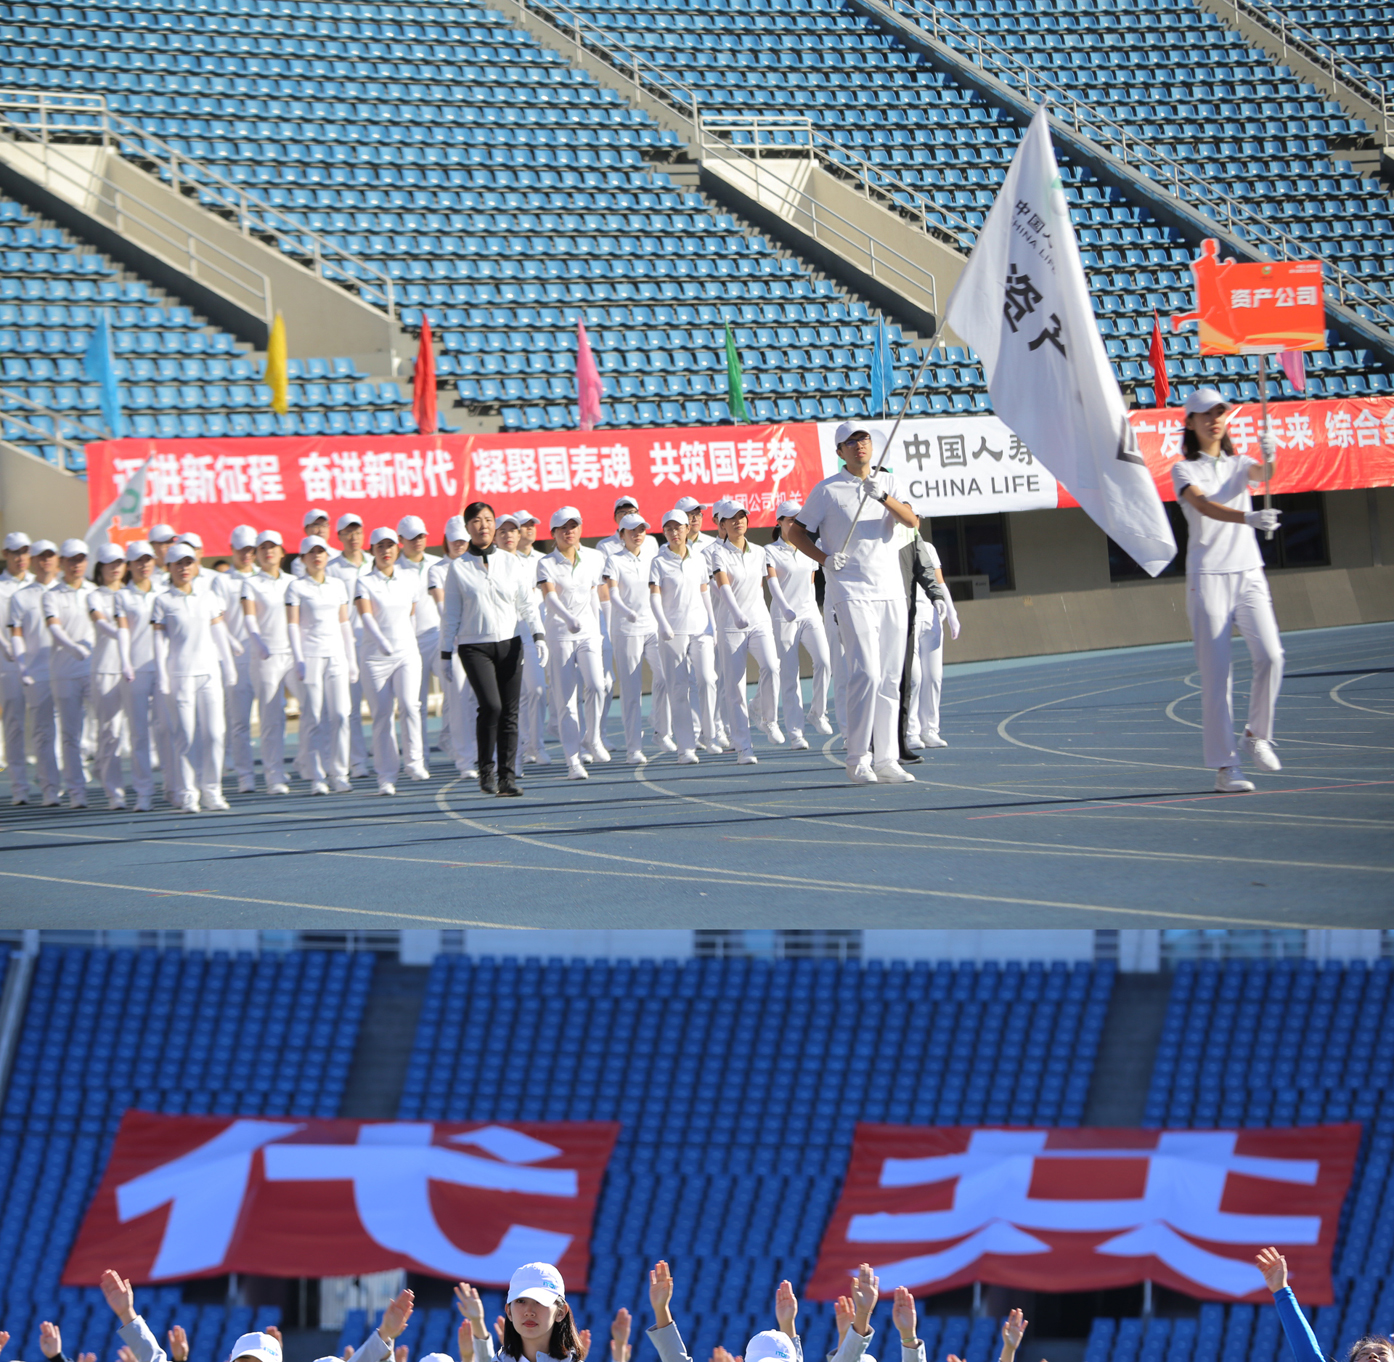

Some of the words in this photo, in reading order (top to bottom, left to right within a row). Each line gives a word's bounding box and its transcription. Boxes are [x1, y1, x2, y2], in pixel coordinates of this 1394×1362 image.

[1012, 215, 1037, 250] HINA
[1230, 286, 1319, 309] 资产公司
[300, 449, 457, 501] 奋进新时代
[472, 443, 634, 494] 凝聚国寿魂
[648, 437, 798, 486] 共筑国寿梦
[909, 477, 982, 498] CHINA
[991, 474, 1040, 494] LIFE
[115, 1119, 578, 1282] 代
[846, 1130, 1321, 1297] 共
